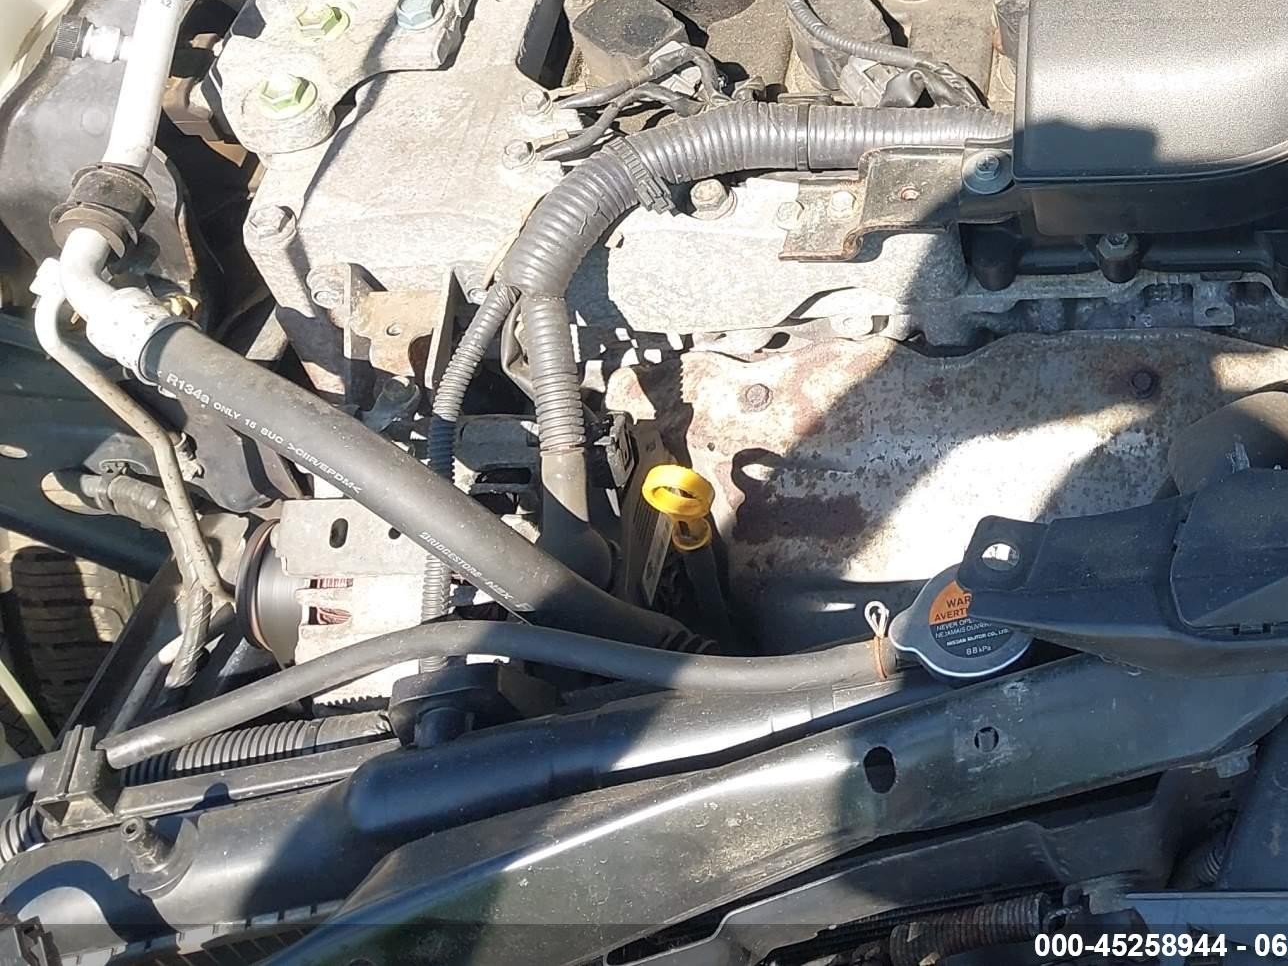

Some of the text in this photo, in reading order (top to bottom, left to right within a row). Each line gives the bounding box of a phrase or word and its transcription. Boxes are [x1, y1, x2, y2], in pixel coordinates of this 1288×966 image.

[166, 373, 210, 405] R134a
[213, 401, 241, 420] ONLY
[946, 595, 972, 609] WAR
[934, 607, 970, 622] AVERT
[936, 620, 958, 632] NEVER
